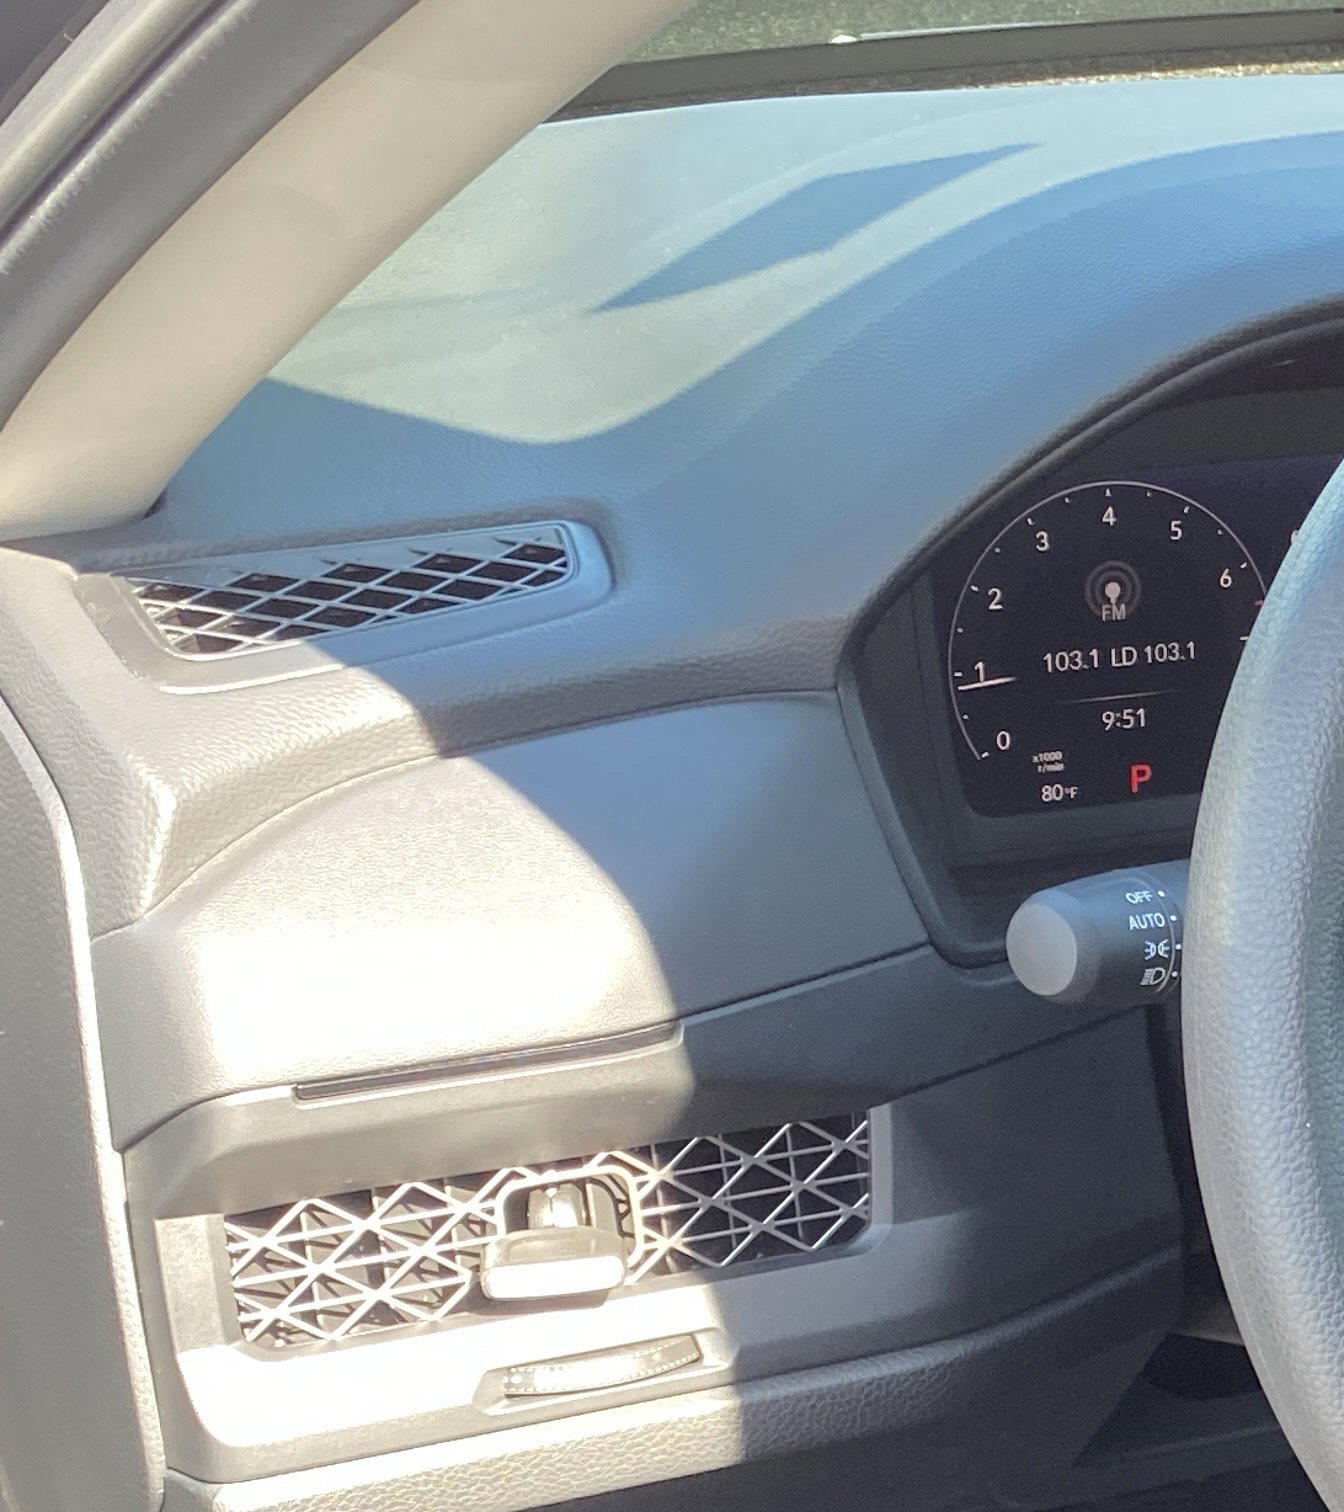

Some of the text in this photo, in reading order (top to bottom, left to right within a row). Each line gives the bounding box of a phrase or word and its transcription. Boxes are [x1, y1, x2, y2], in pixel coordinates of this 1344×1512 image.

[1102, 507, 1116, 526] 4
[1170, 520, 1183, 541] 5
[1036, 531, 1050, 552] 3
[1219, 568, 1233, 588] 6
[988, 588, 1003, 611] 2
[1101, 604, 1127, 622] FM
[1043, 641, 1196, 673] 103.1 LD 103.1
[974, 661, 986, 682] 1
[1101, 708, 1146, 731] 9:51
[996, 731, 1011, 751] 0
[1131, 764, 1153, 794] P
[1126, 890, 1153, 904] OFF
[1129, 913, 1166, 930] AUTO
